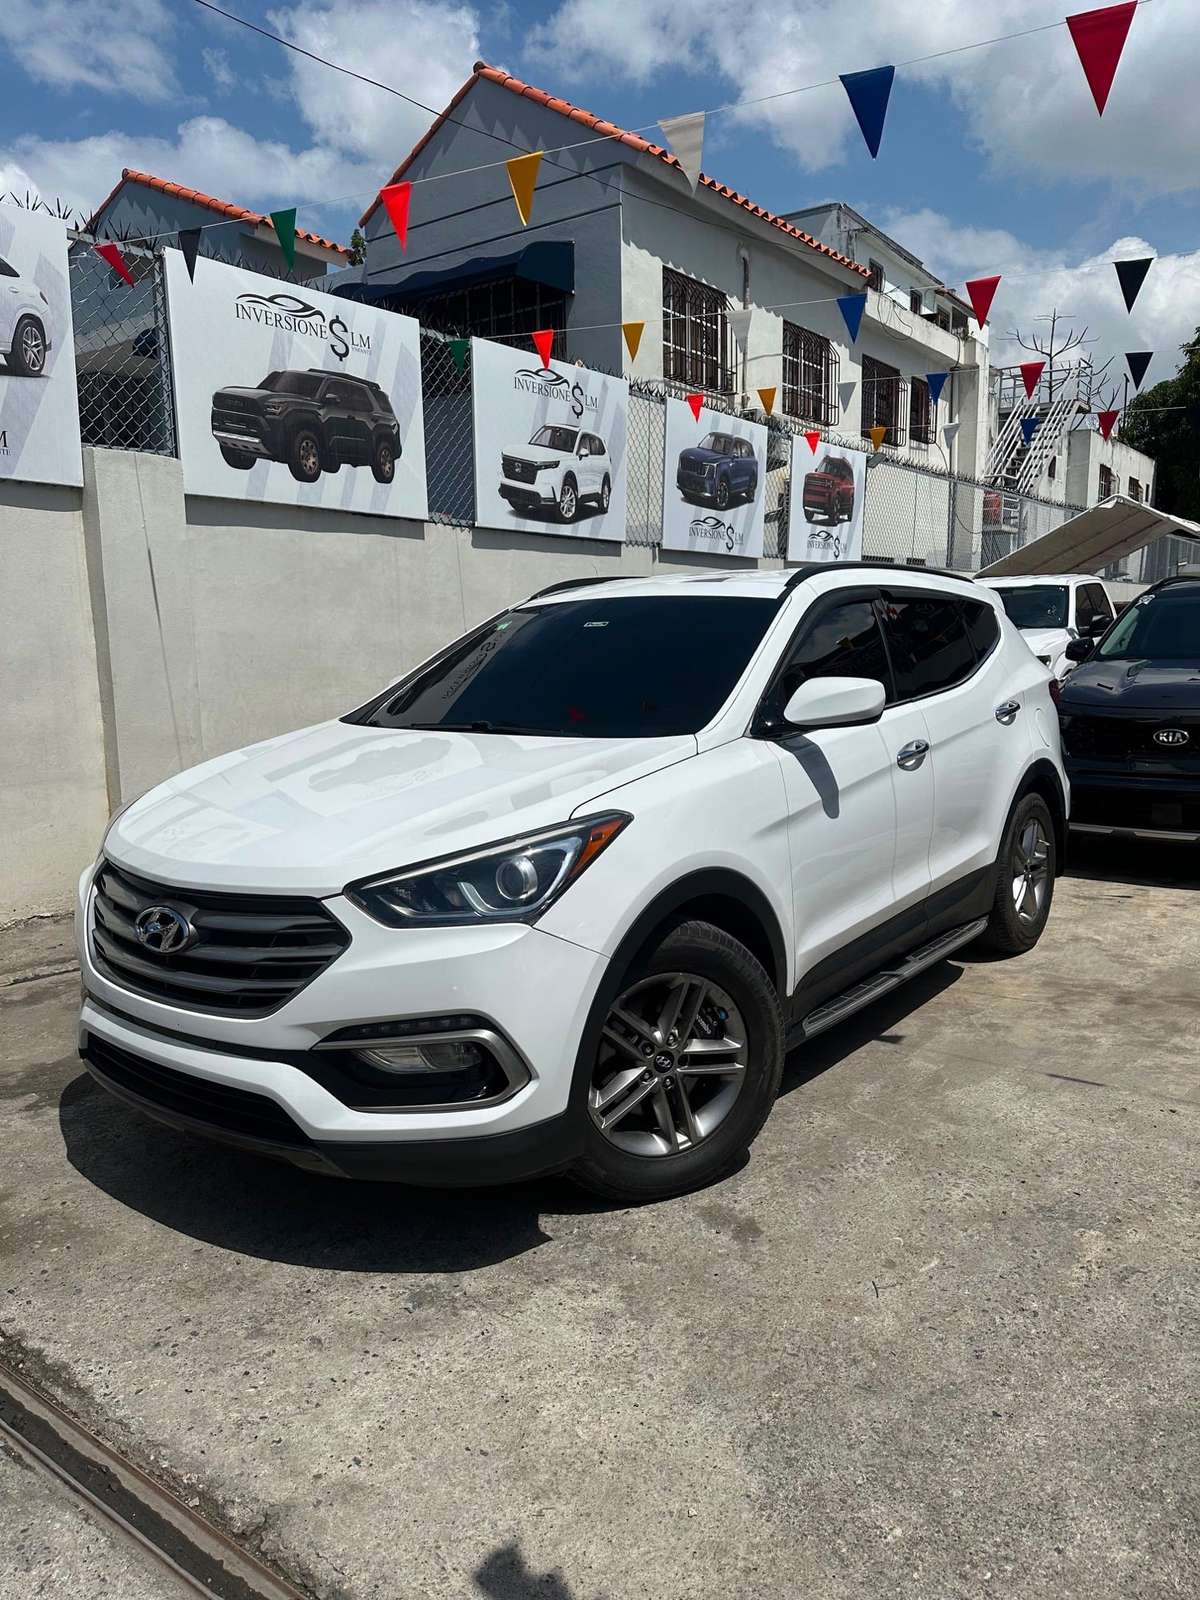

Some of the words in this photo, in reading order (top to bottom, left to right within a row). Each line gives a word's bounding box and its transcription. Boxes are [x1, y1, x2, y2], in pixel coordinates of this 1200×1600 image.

[350, 331, 371, 350] LM
[584, 394, 598, 409] LM
[1159, 732, 1183, 742] KIA
